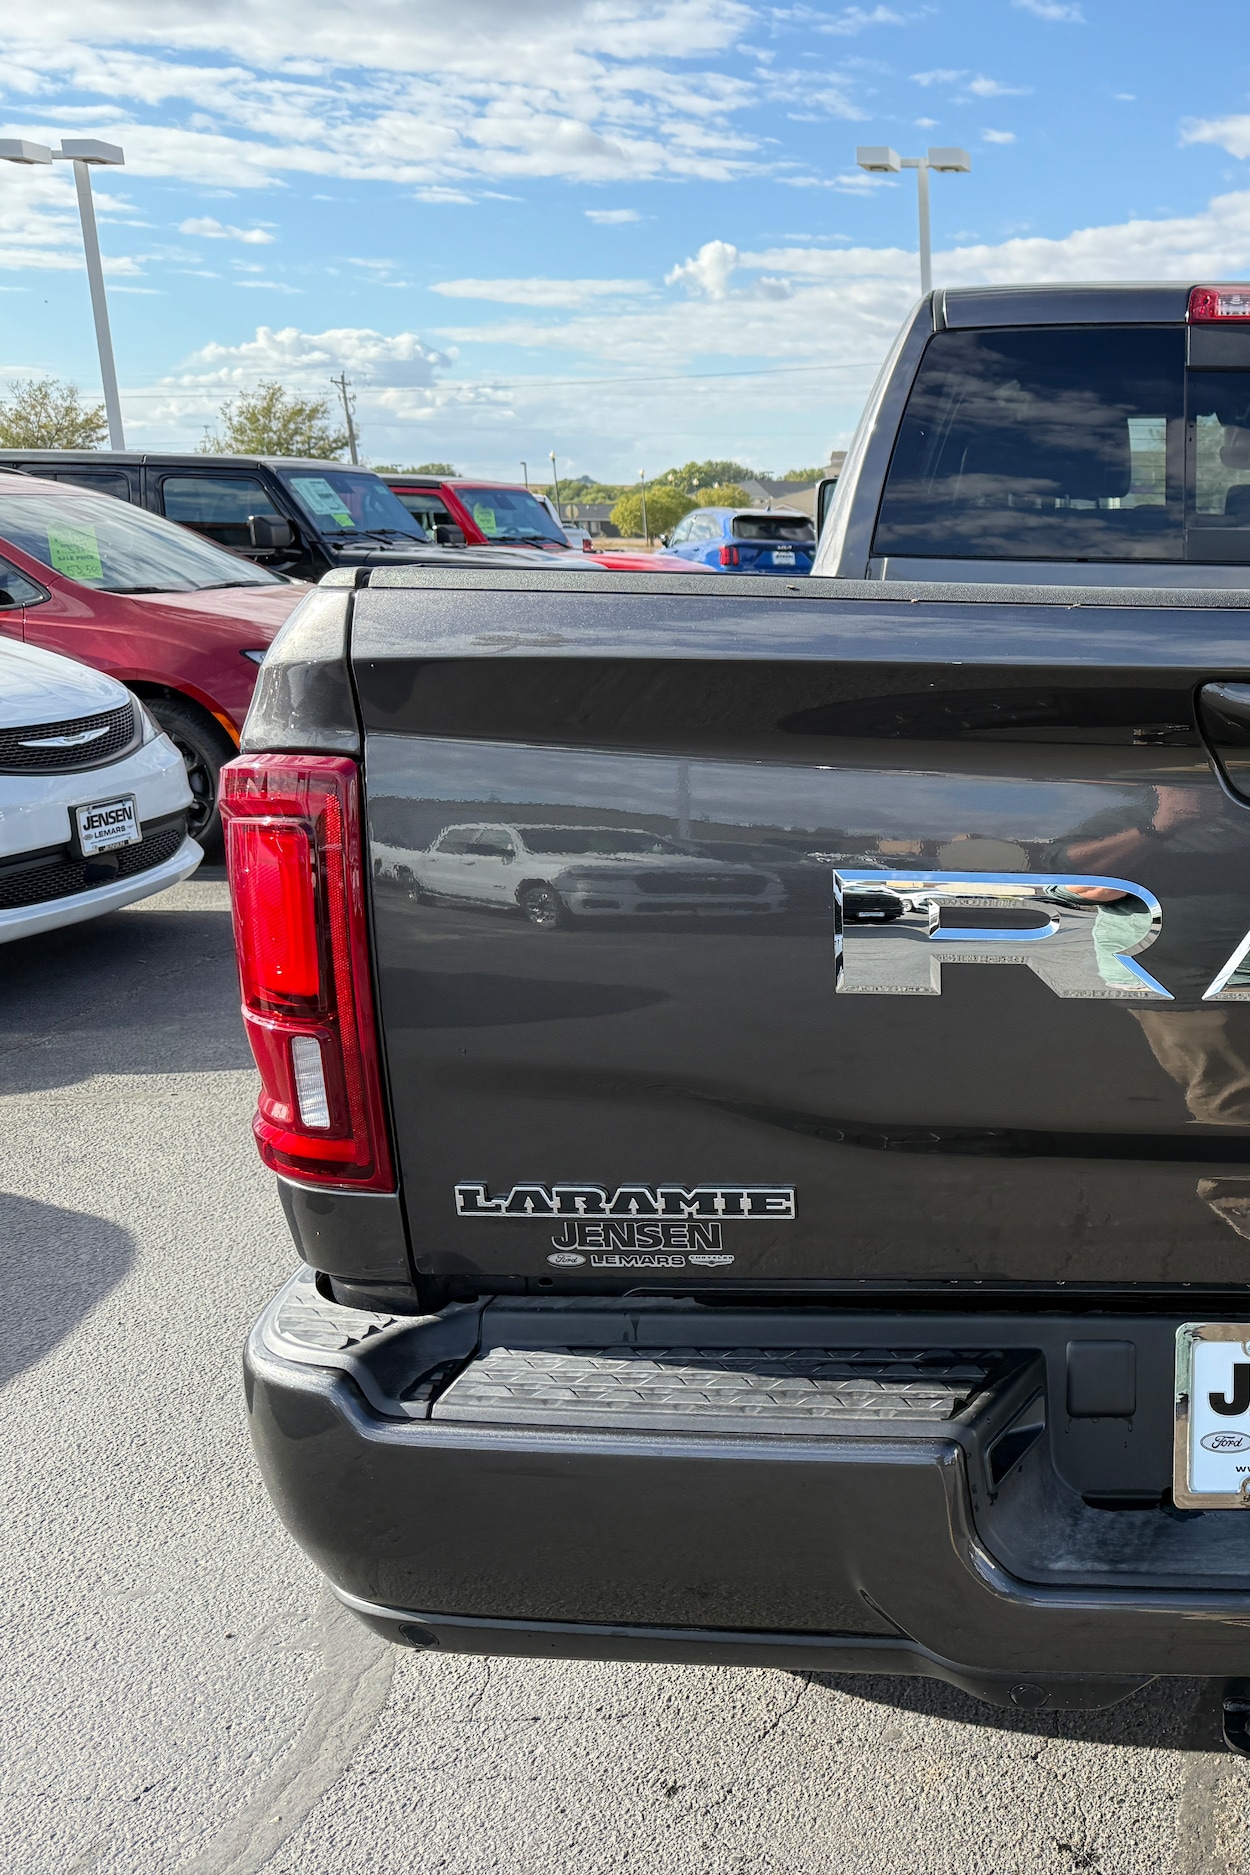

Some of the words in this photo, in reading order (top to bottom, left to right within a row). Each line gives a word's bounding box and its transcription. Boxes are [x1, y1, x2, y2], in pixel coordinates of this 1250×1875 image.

[83, 805, 132, 831] JENSEN
[94, 825, 126, 839] LEMARS
[454, 1181, 798, 1220] LARAMIE
[551, 1221, 723, 1252] JENSEN
[590, 1254, 686, 1268] LEMARS
